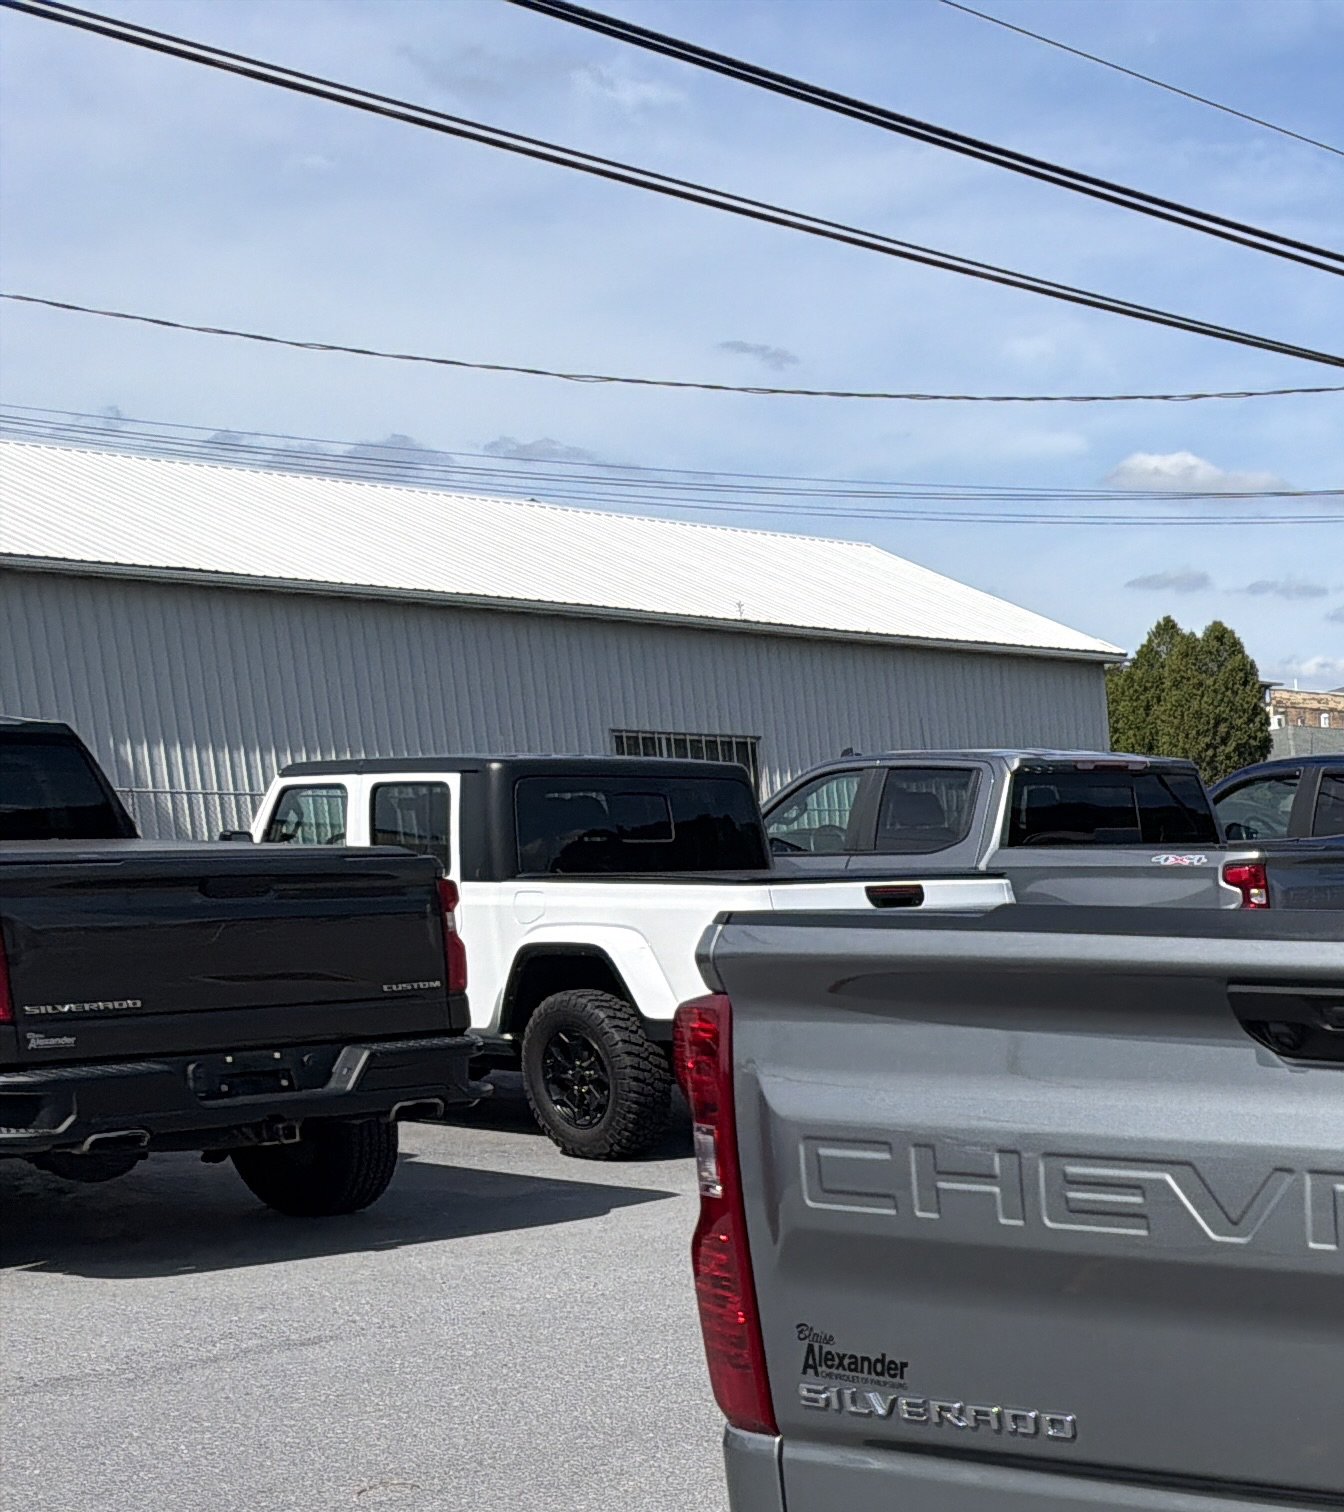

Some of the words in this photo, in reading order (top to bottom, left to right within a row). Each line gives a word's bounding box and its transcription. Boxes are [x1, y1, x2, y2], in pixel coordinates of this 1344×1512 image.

[382, 980, 441, 992] CUSTOM
[23, 1000, 142, 1015] SILVERADO
[795, 1323, 836, 1346] Blaise
[801, 1343, 909, 1380] Alexander
[799, 1383, 1077, 1440] SILVERADO
